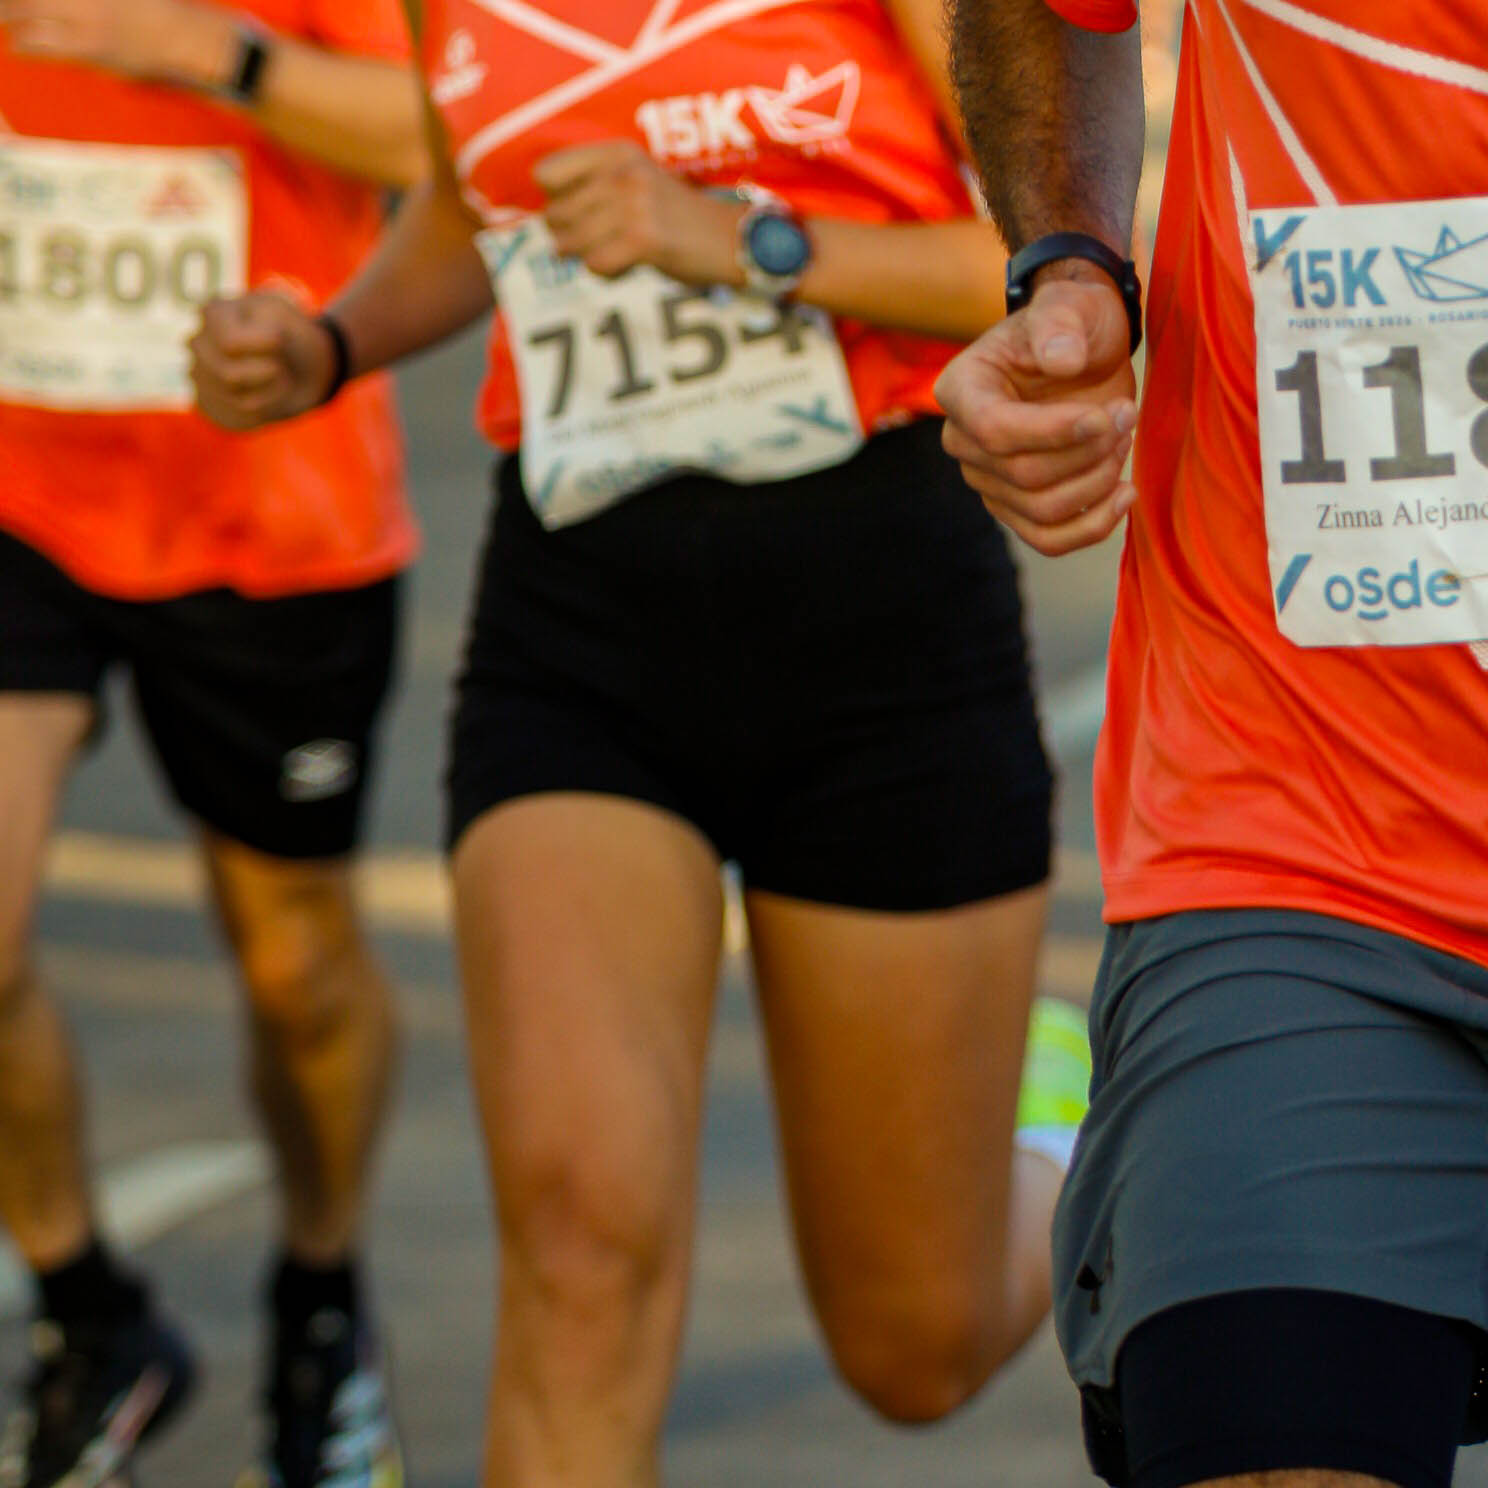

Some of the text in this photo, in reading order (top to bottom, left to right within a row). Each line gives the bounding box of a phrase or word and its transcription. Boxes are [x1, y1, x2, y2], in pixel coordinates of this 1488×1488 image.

[634, 87, 757, 161] 15K
[1284, 248, 1387, 310] 15K
[529, 292, 812, 419] 7154
[1316, 502, 1384, 530] Zinna
[1324, 558, 1461, 614] osde
